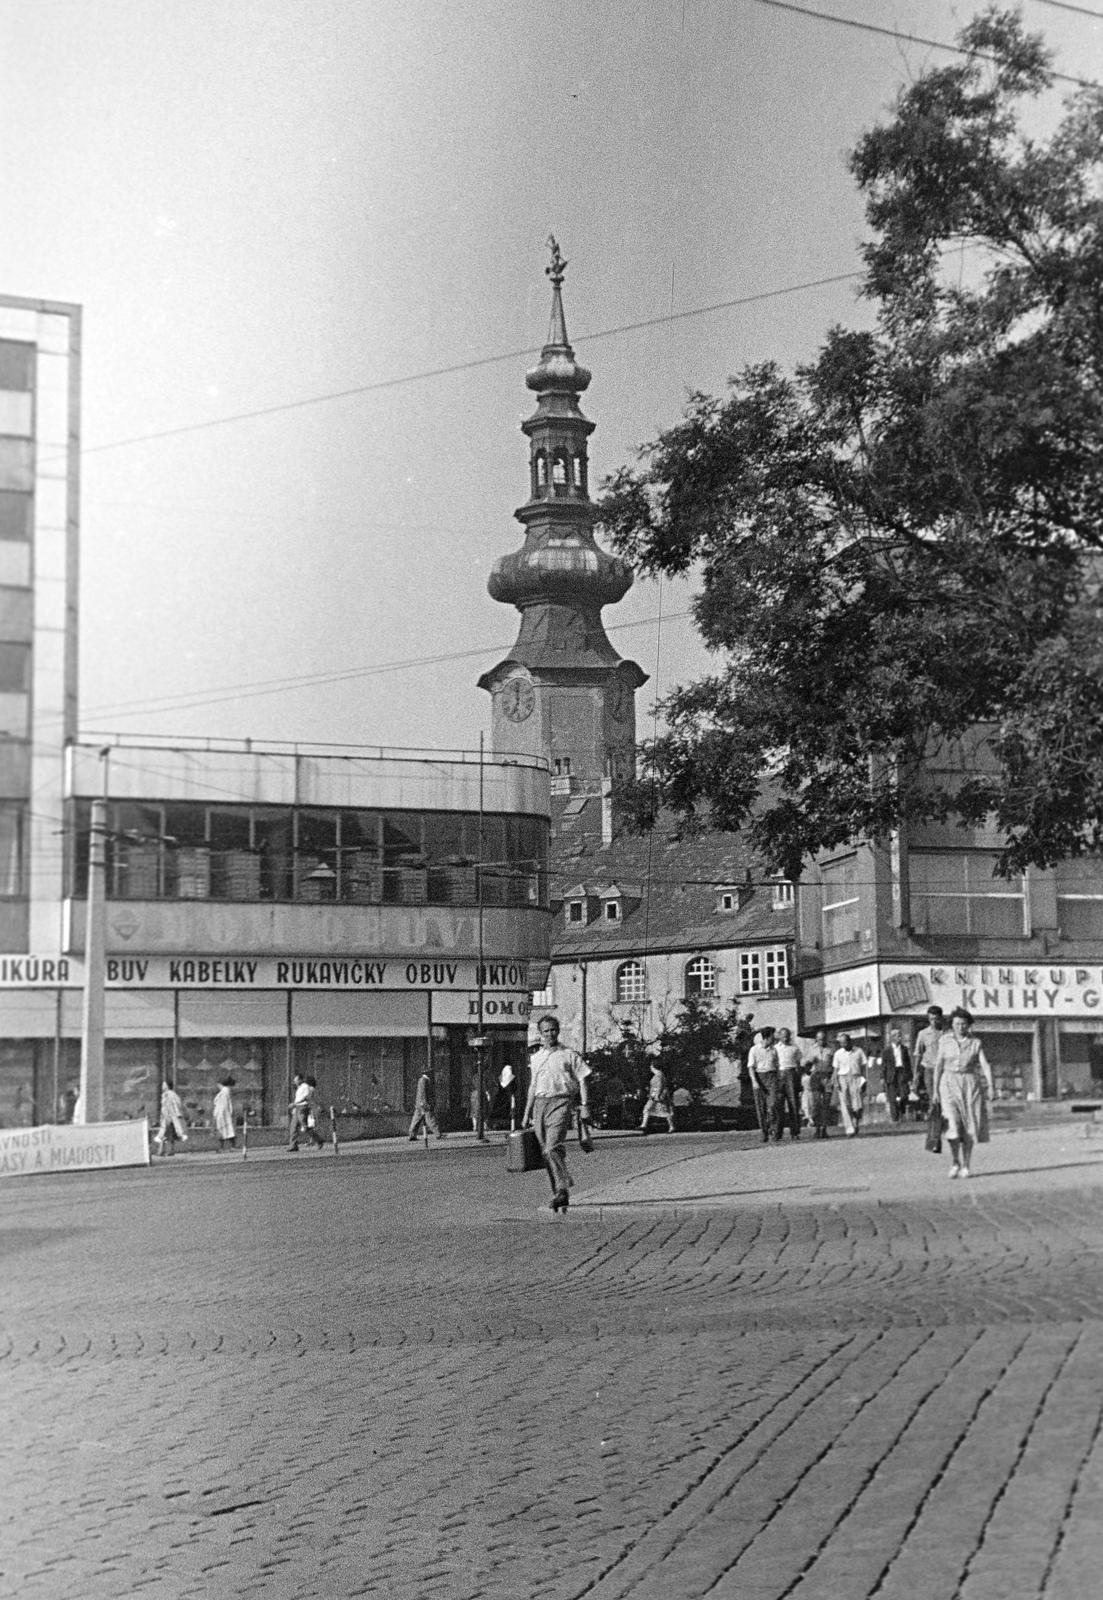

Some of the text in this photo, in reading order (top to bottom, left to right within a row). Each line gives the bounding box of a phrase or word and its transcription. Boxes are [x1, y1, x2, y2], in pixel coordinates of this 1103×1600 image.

[107, 959, 149, 982] BUV
[169, 959, 258, 984] KABELKY
[276, 959, 387, 985] RUKAVIČKY
[405, 962, 458, 985] OBUV
[929, 967, 1103, 986] KNIHKUP
[468, 1000, 514, 1016] DOM
